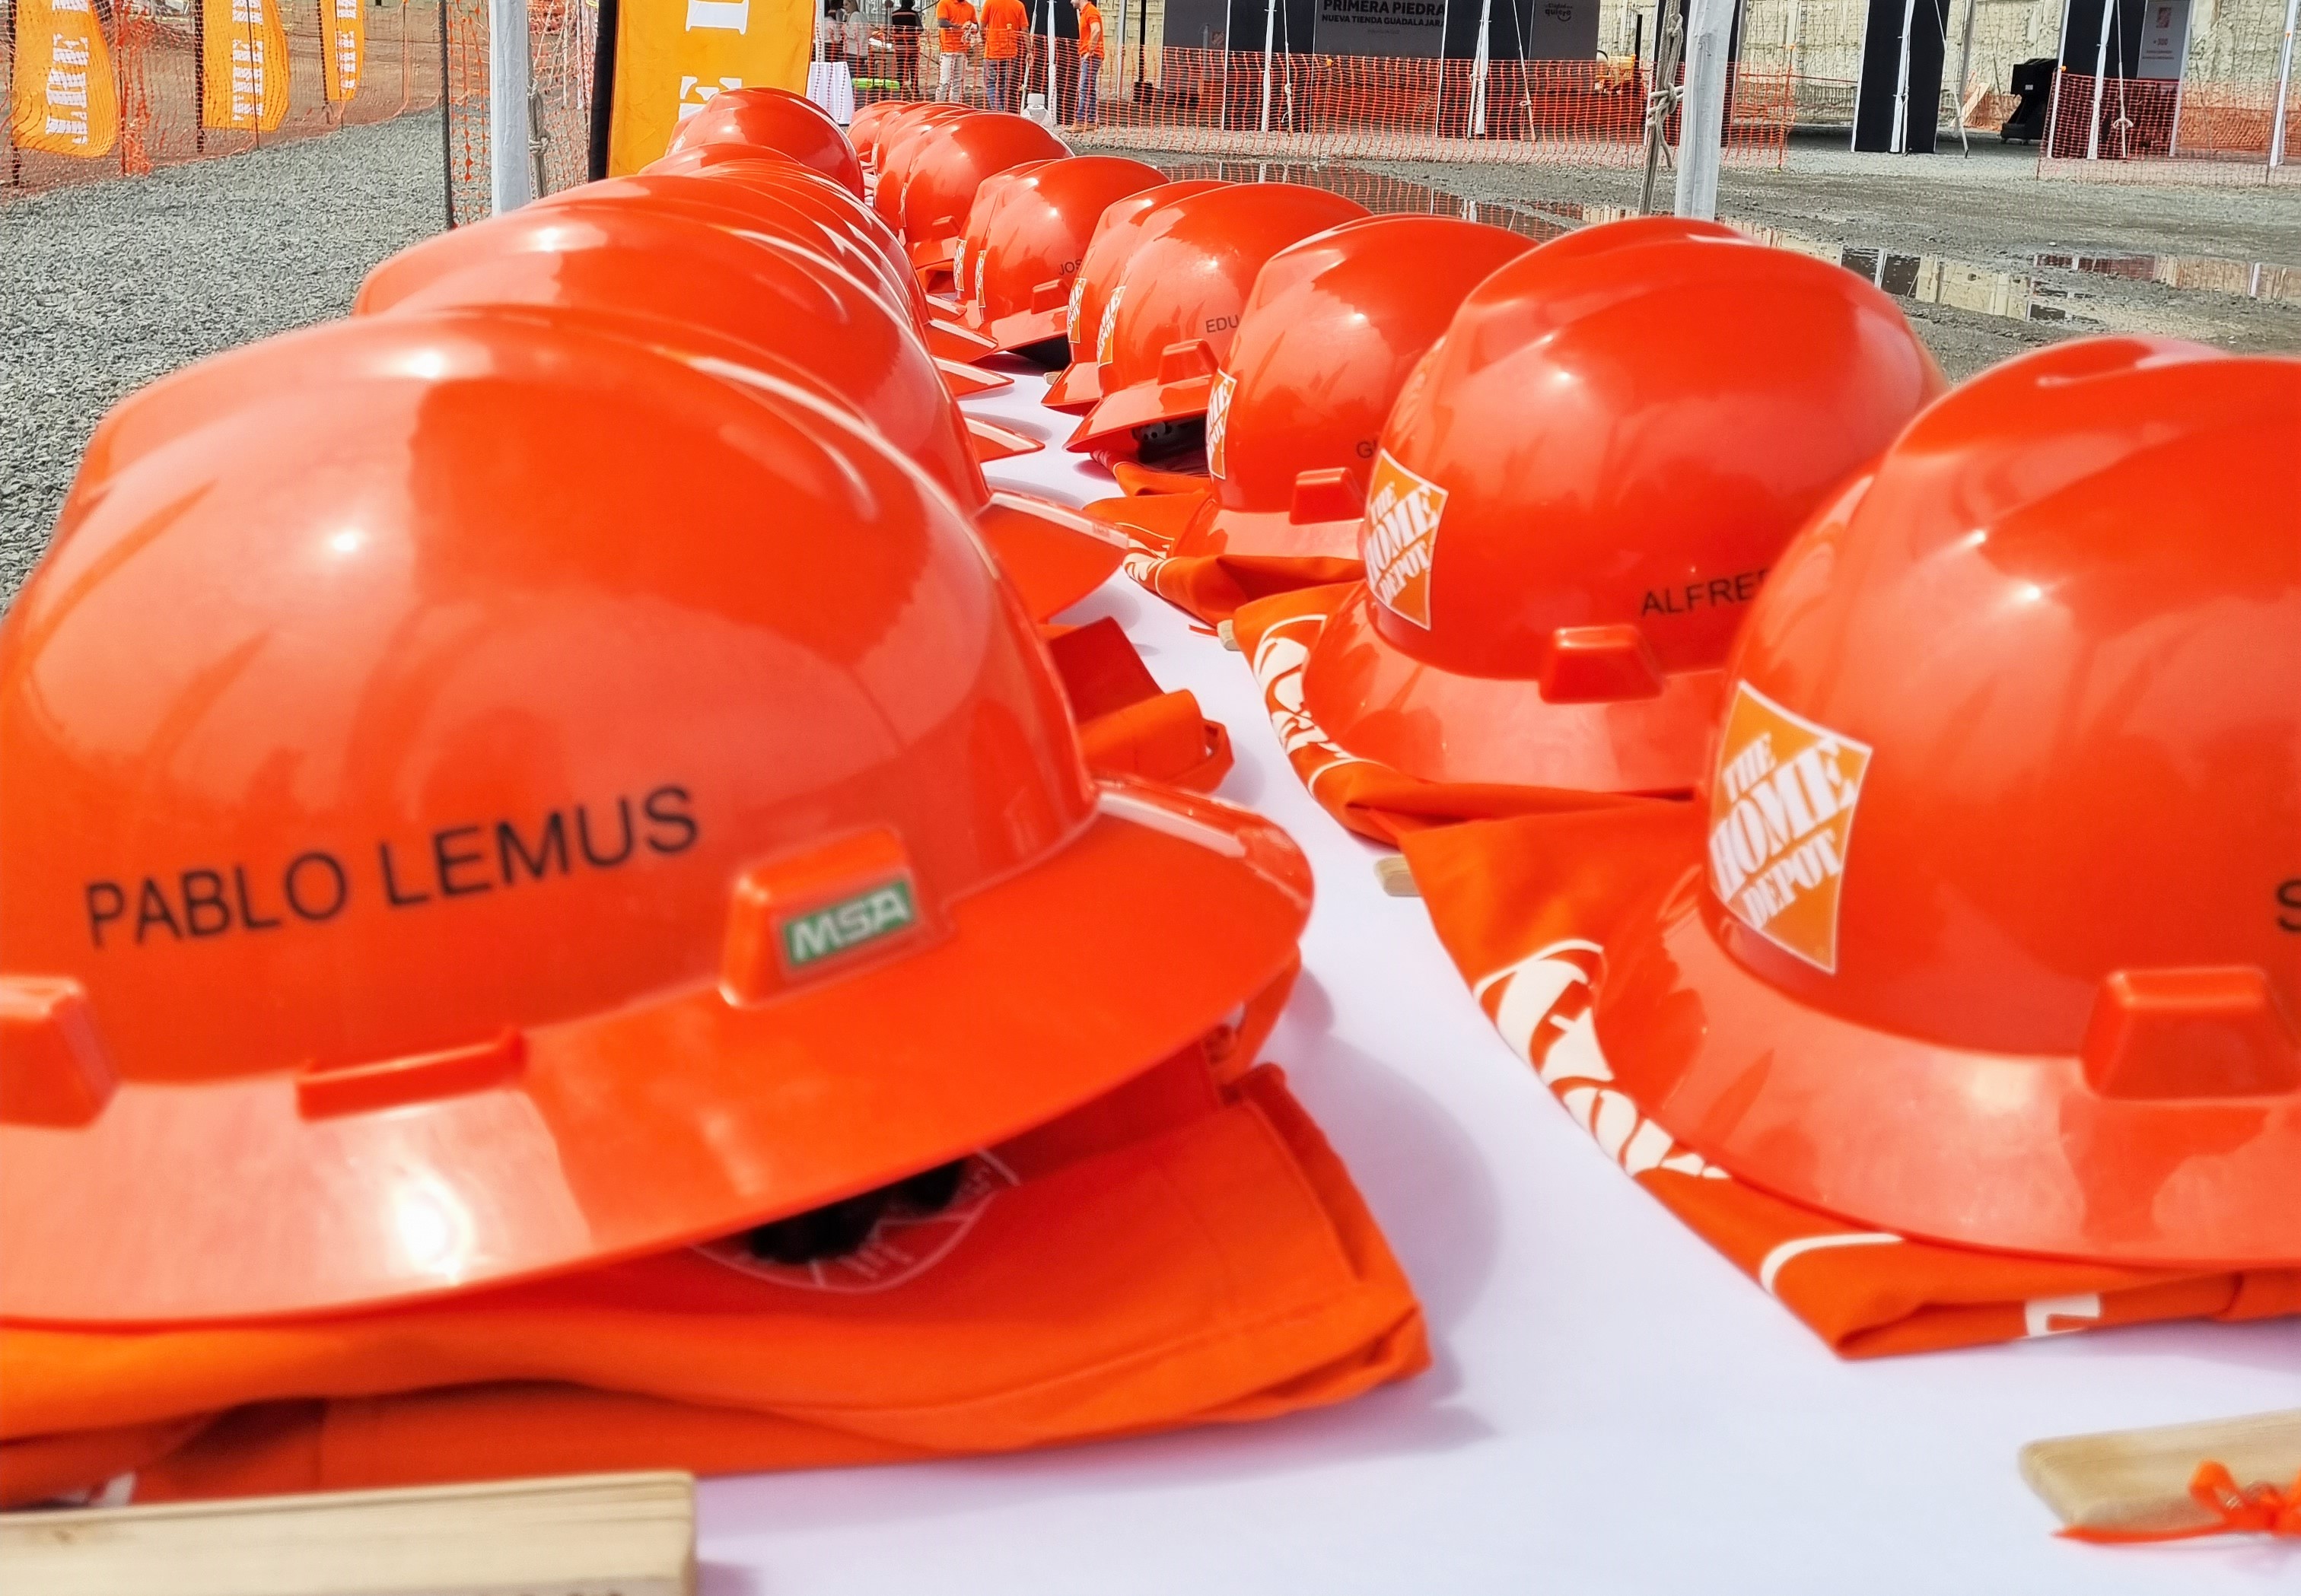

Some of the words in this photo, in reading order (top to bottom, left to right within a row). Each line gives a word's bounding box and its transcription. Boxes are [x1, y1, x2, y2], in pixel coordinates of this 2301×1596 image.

[1322, 14, 1351, 23] NUEVA
[1352, 15, 1383, 24] TIENDA
[1323, 0, 1389, 14] PRIMERA
[1392, 2, 1444, 16] PIEDRA
[232, 39, 263, 121] THE
[1205, 314, 1240, 333] EDU
[1722, 730, 1778, 803] THE
[1709, 735, 1857, 904] HOME
[84, 850, 350, 949] PABLO
[379, 785, 700, 910] LEMUS
[1742, 828, 1842, 930] DEPOT
[791, 887, 911, 963] MSA
